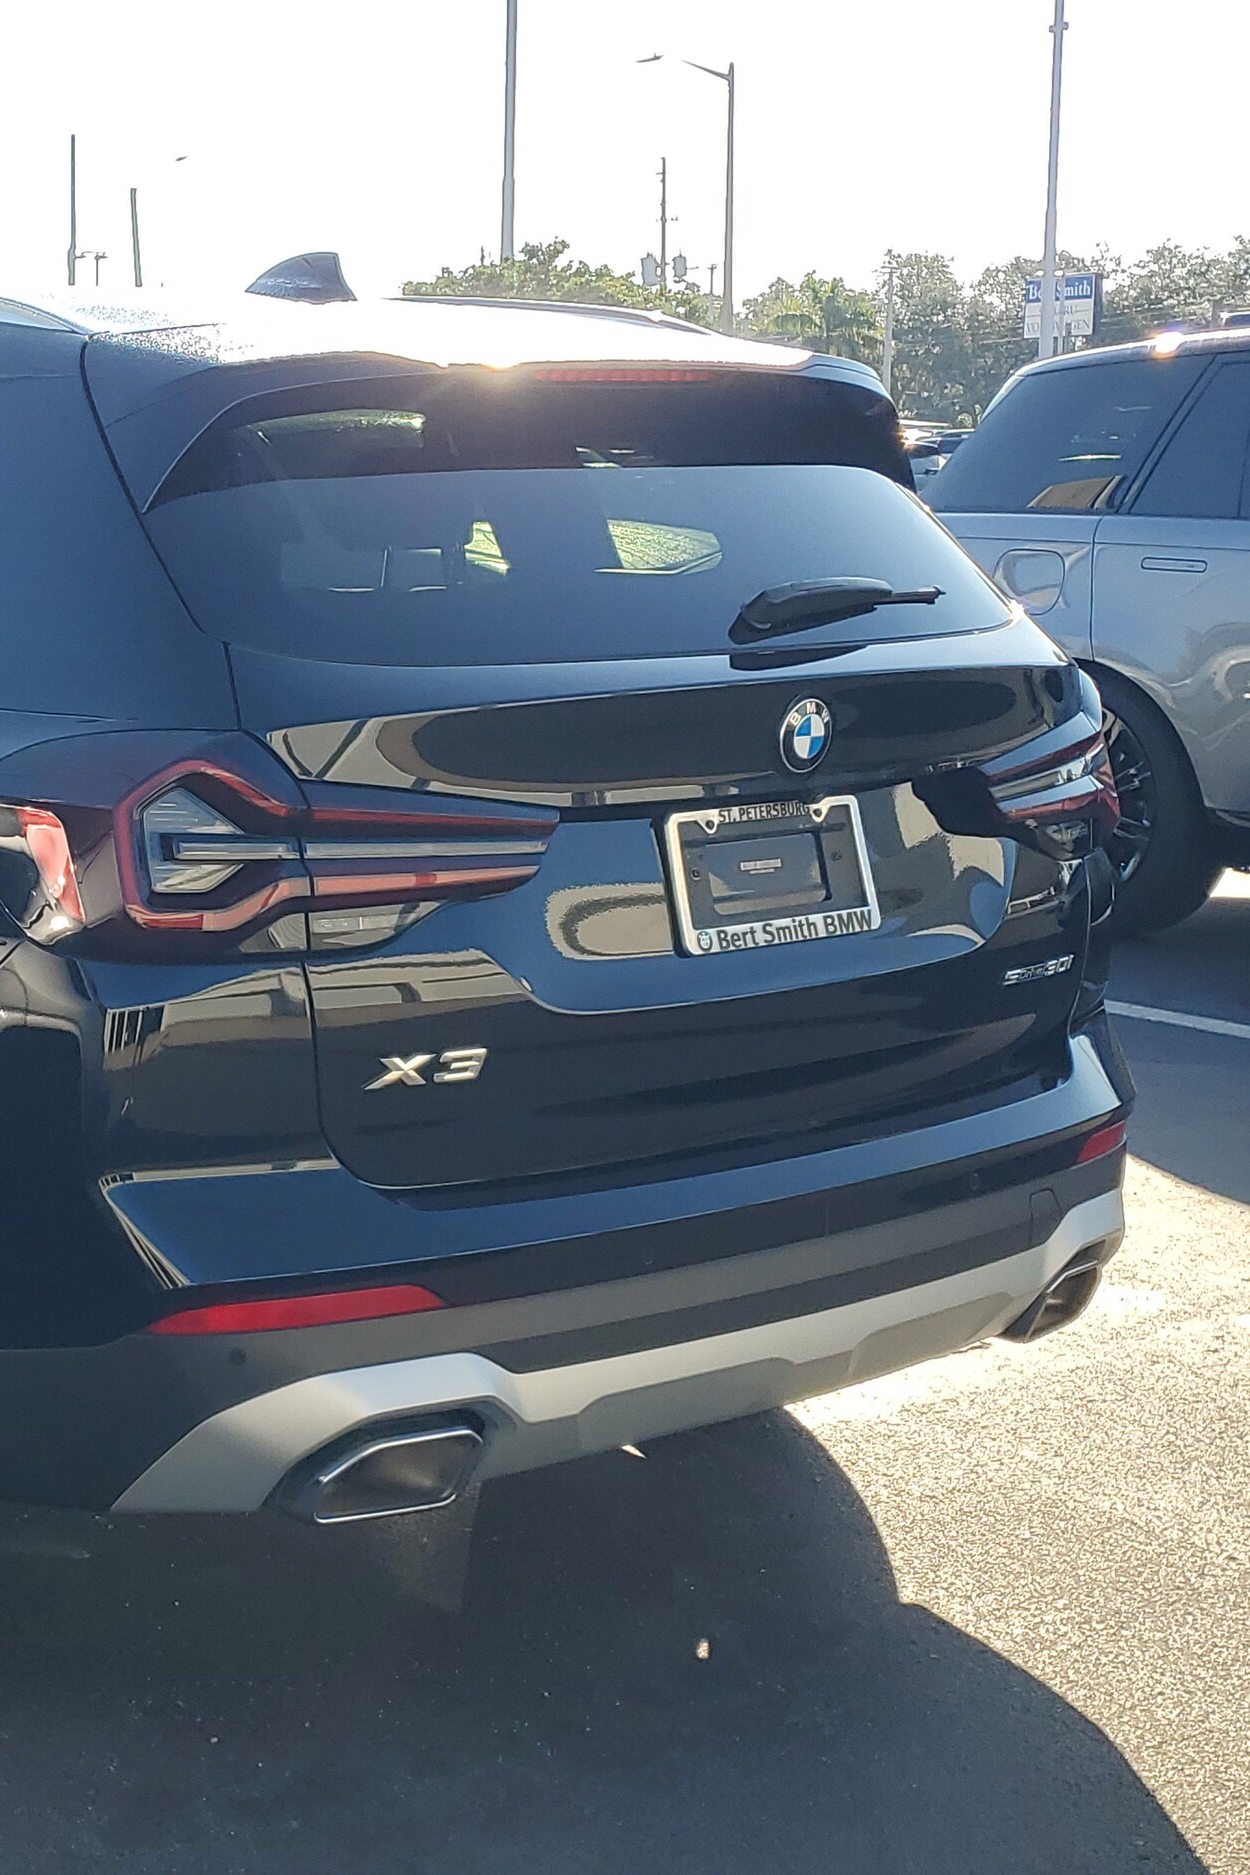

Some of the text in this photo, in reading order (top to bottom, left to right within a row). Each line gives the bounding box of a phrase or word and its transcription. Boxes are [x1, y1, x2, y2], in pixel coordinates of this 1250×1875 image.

[790, 702, 830, 726] BMW
[718, 801, 810, 823] ST. PETERSBURG
[716, 909, 873, 951] Bert Smith BMW
[361, 1047, 488, 1091] X3
